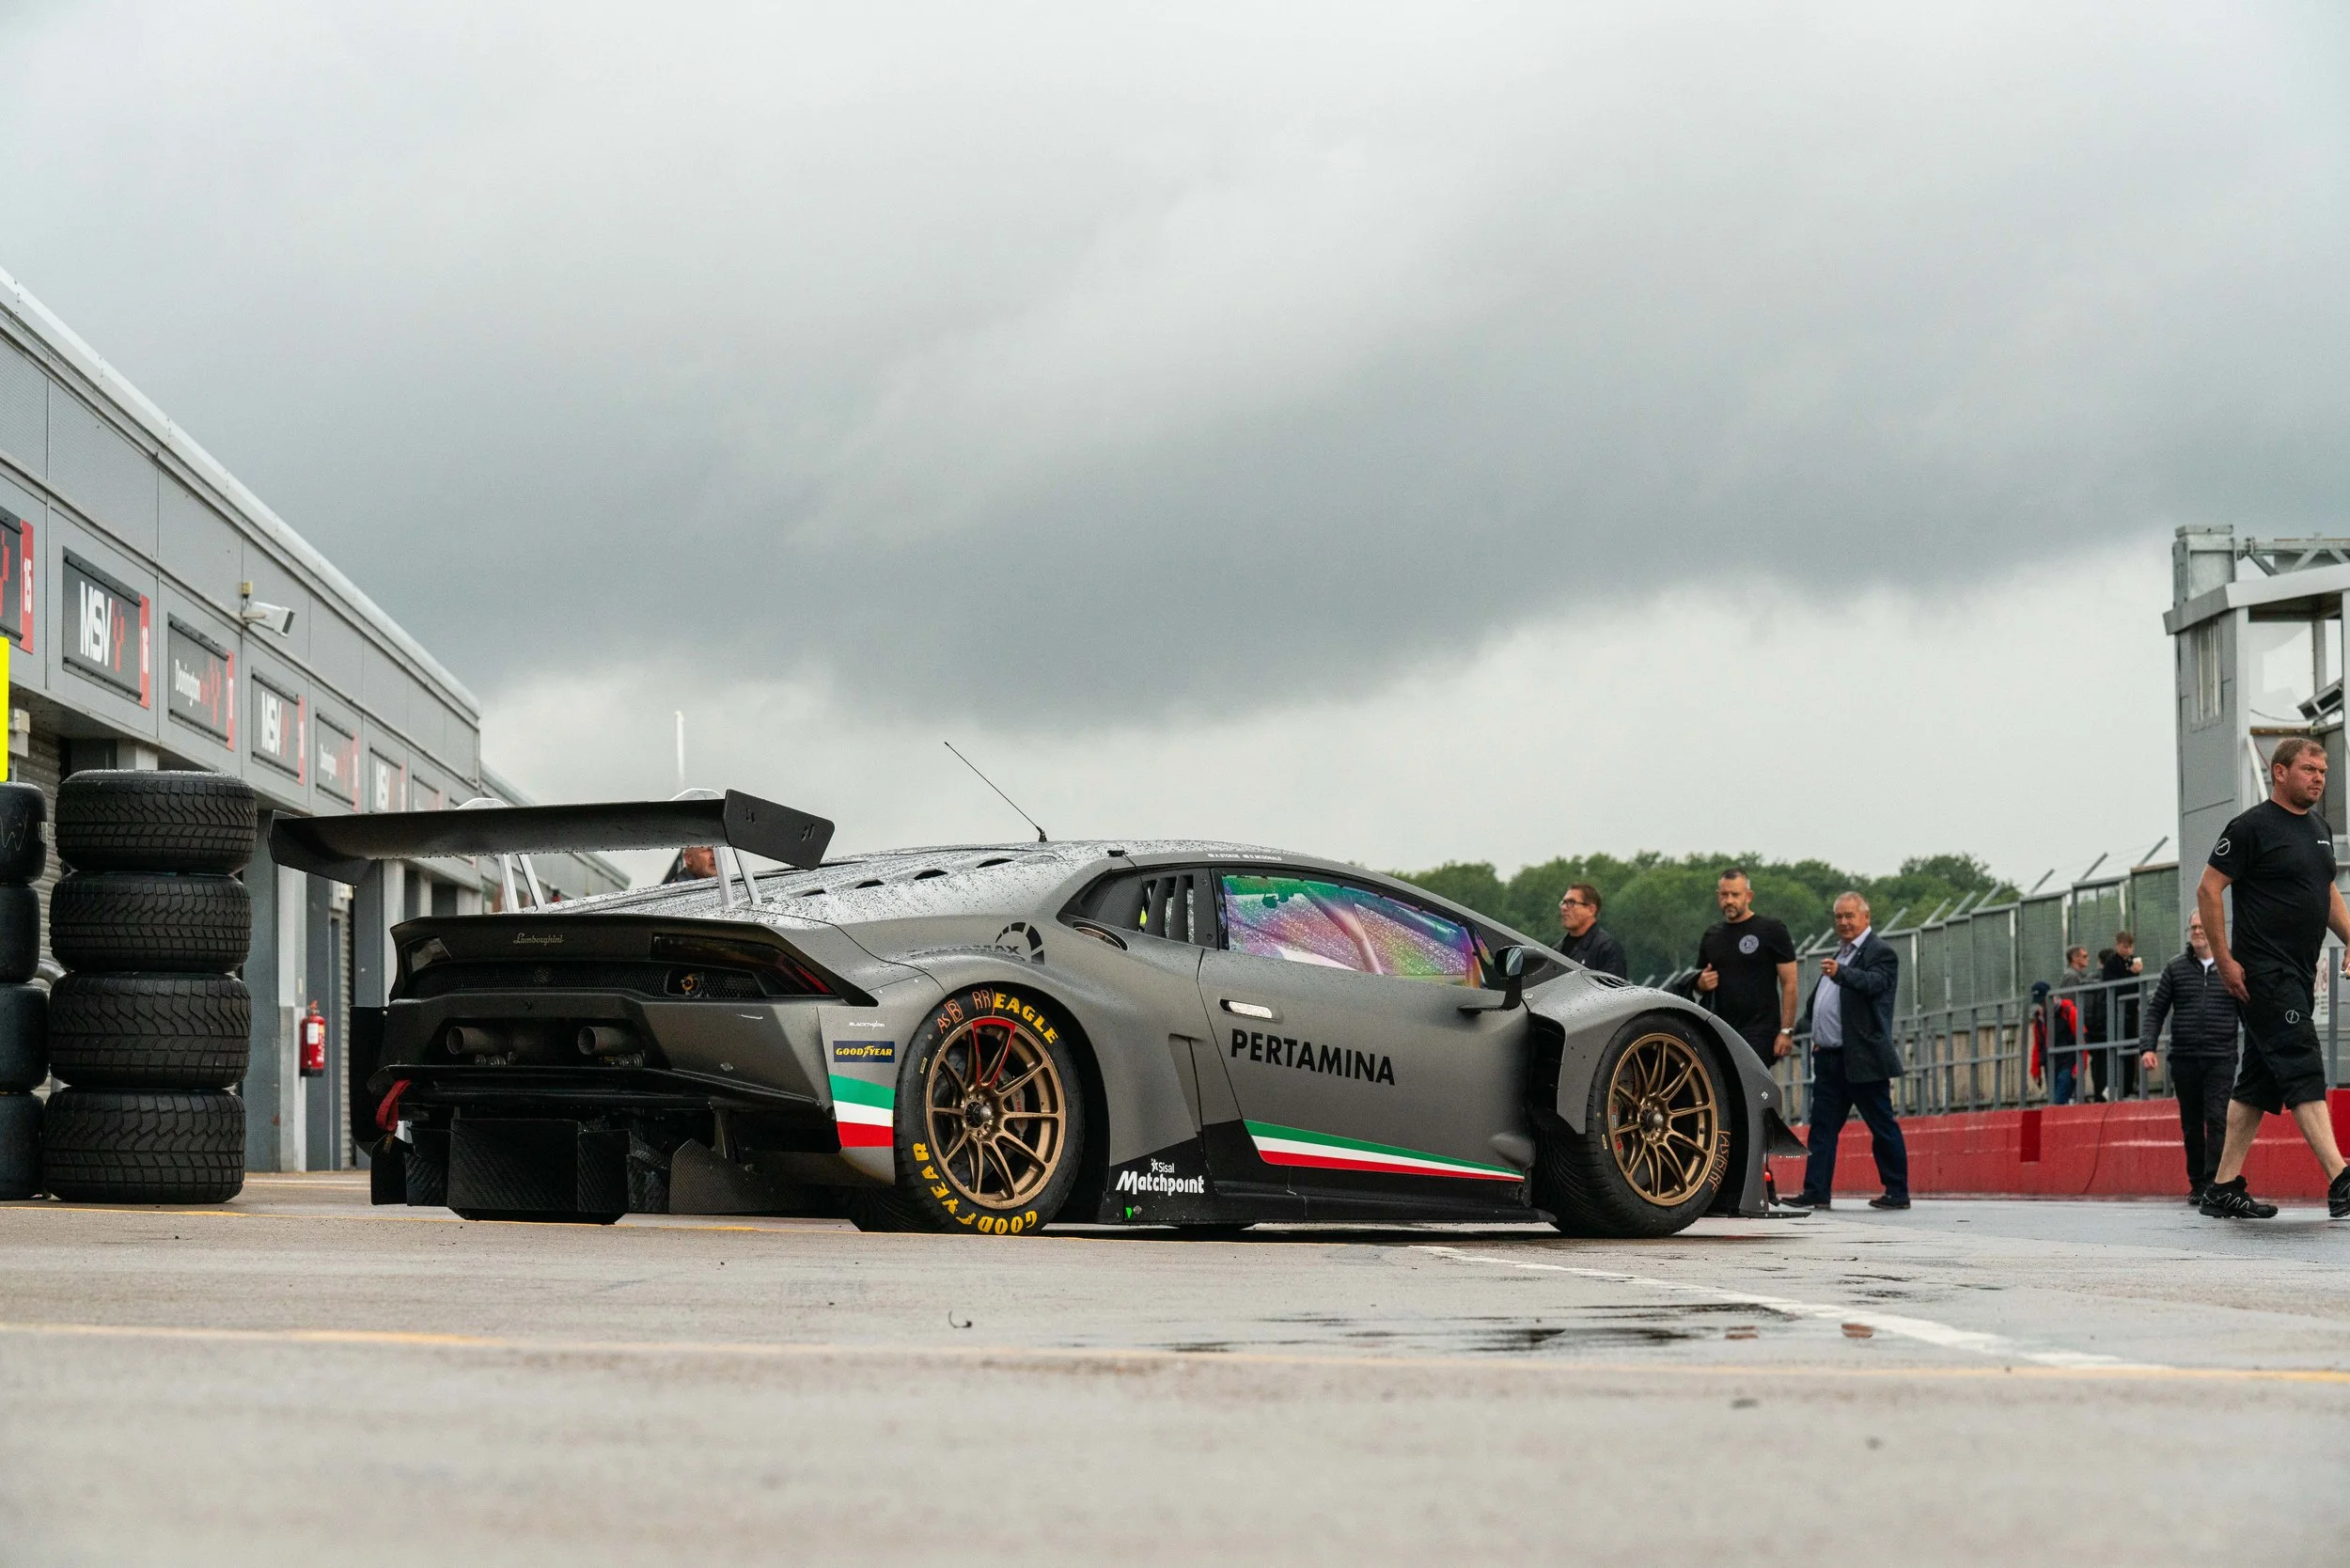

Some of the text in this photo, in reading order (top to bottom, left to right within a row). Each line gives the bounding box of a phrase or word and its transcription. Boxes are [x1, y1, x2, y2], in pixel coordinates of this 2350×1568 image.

[80, 580, 112, 667] MSV
[512, 933, 564, 947] Lamborghini
[994, 992, 1058, 1044] EAGLE
[836, 1045, 893, 1058] GOODYEAR
[1230, 1028, 1395, 1086] PERTAMINA
[1115, 1170, 1204, 1196] Matchpoint
[1158, 1162, 1175, 1173] Sisal
[913, 1142, 1038, 1235] GOODYEAR
